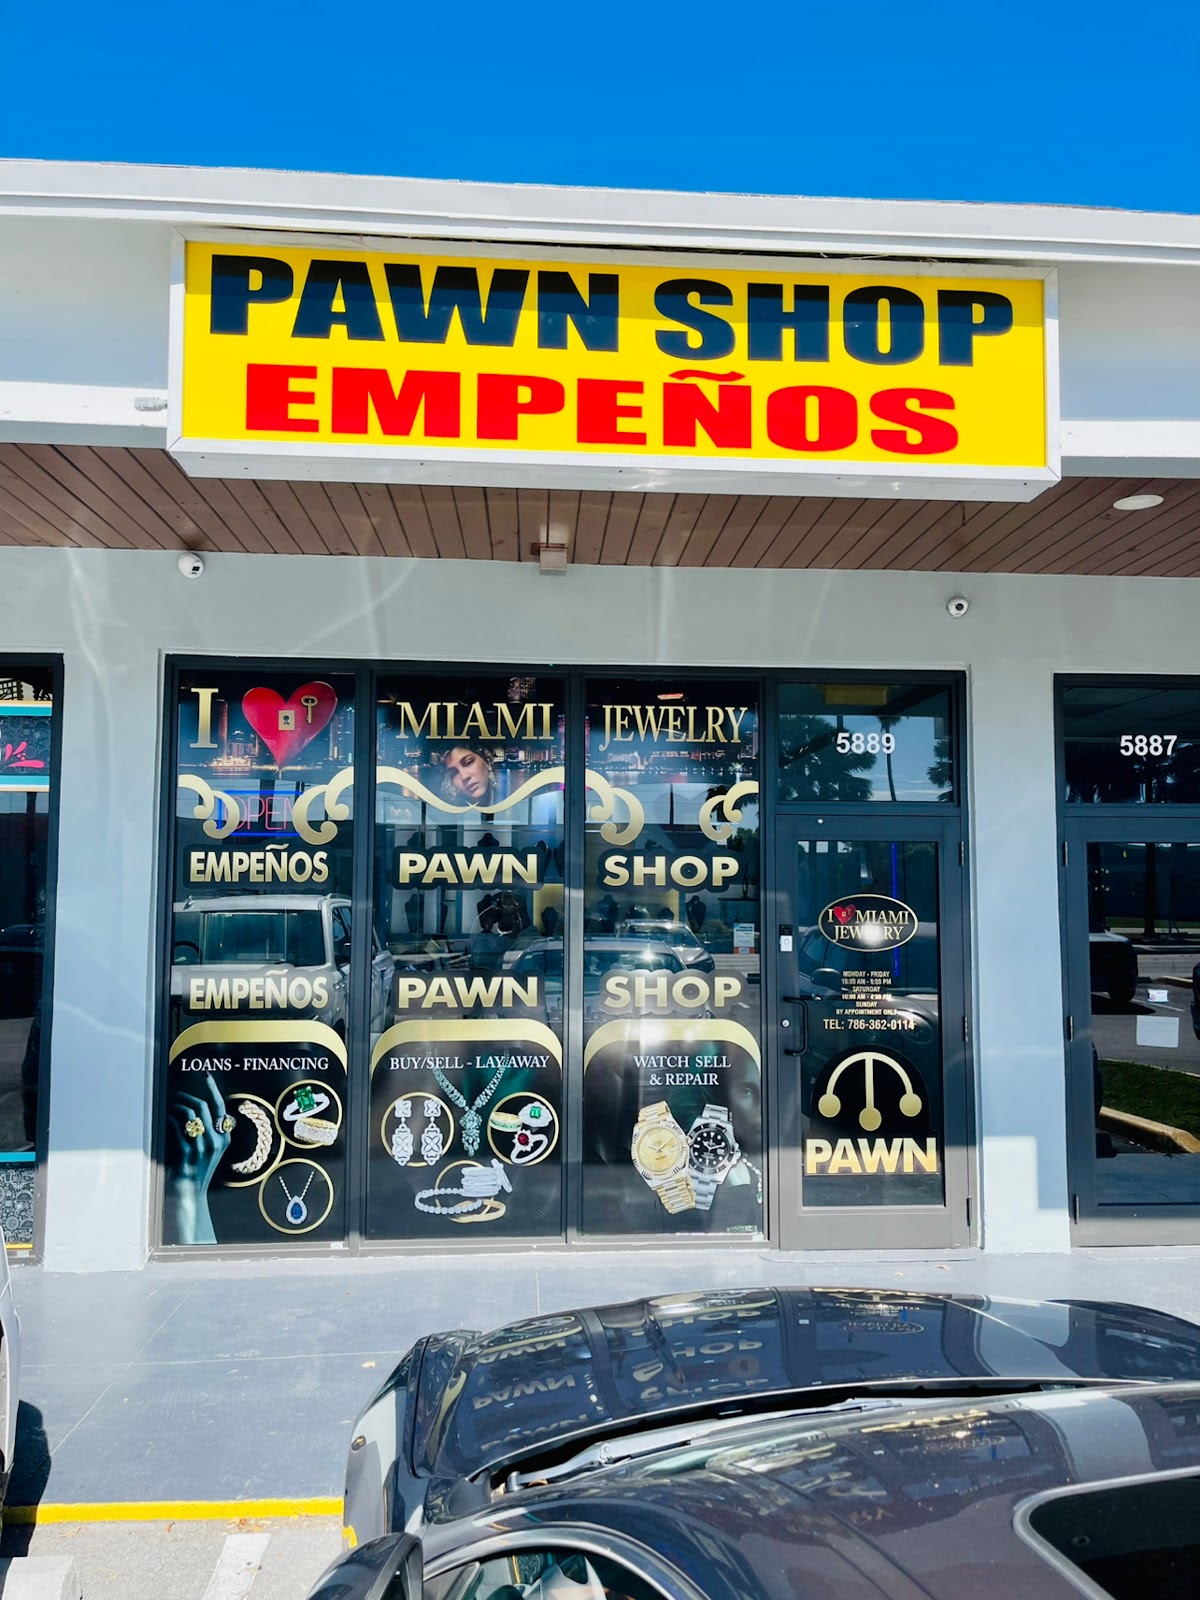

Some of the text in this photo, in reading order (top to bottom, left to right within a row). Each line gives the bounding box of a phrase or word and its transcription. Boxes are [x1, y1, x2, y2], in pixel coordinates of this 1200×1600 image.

[210, 254, 1013, 366] PAWN SHOP
[246, 363, 959, 455] EMPEÑOS
[190, 688, 748, 751] I MIAMI JEWELRY
[836, 732, 895, 754] 5889
[1119, 735, 1177, 756] 5887
[190, 843, 329, 883] EMPEÑOS
[399, 852, 739, 886] PAWN SHOP
[855, 910, 910, 925] MIAMI
[833, 926, 905, 942] JEWRY
[189, 969, 329, 1010] EMPEÑOS
[398, 976, 742, 1009] PAWN SHOP
[823, 1019, 915, 1030] TEL: 786-362-0114
[181, 1058, 232, 1071] LOANS
[242, 1058, 329, 1071] FINANCING
[390, 1057, 464, 1070] BUY/SELL
[634, 1056, 732, 1068] WATCH SELL
[665, 1073, 719, 1085] REPAIR
[806, 1137, 937, 1174] PAWN
